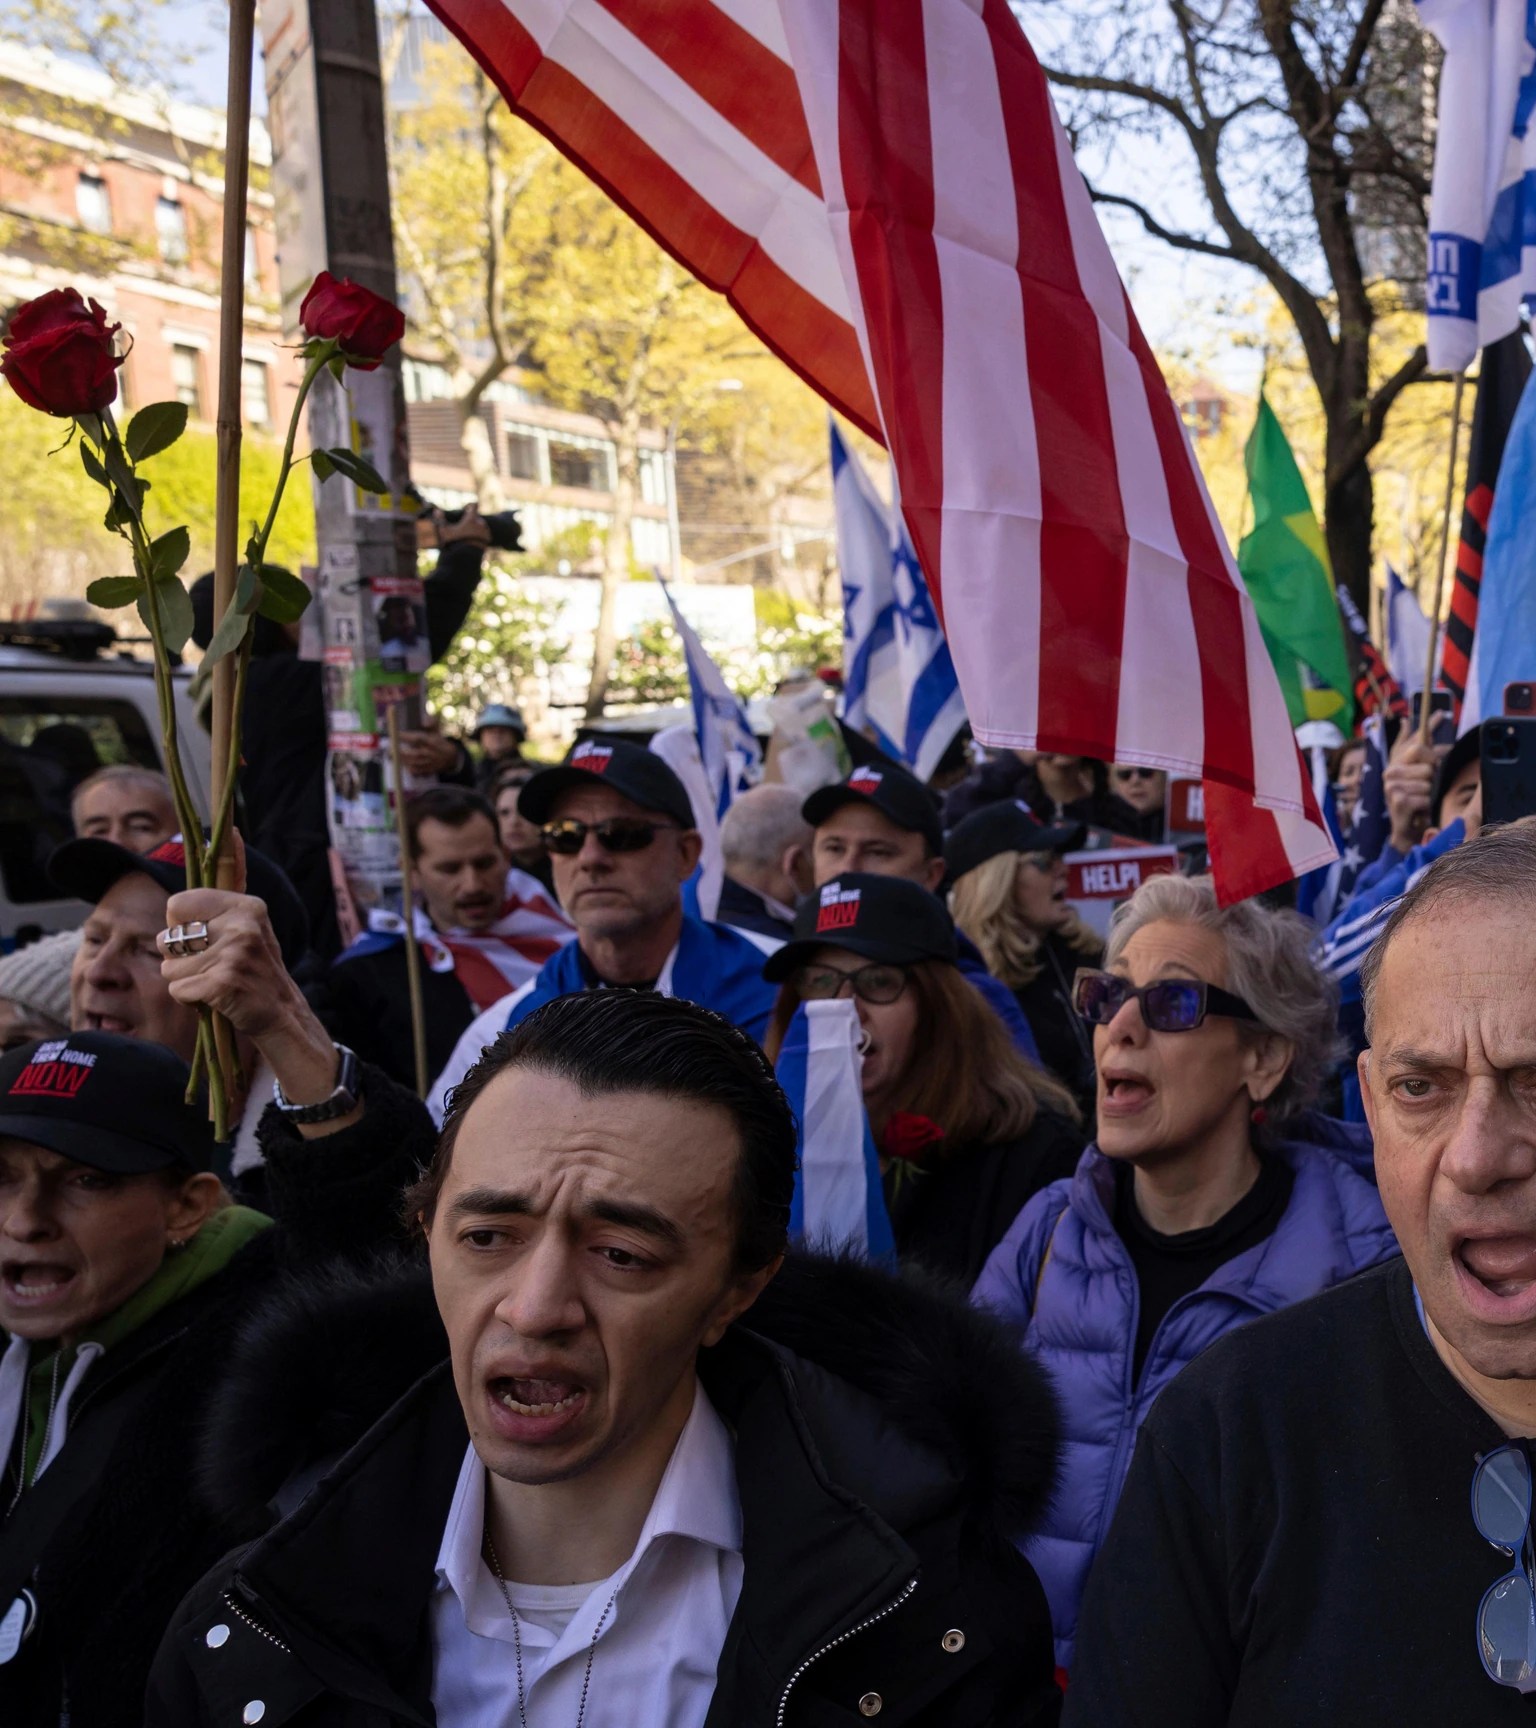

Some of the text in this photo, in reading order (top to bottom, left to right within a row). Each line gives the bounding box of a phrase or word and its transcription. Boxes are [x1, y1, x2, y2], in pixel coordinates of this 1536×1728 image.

[1081, 862, 1143, 893] HELP!
[817, 900, 860, 930] NOW
[60, 1049, 98, 1068] HOME
[12, 1062, 92, 1092] NOW
